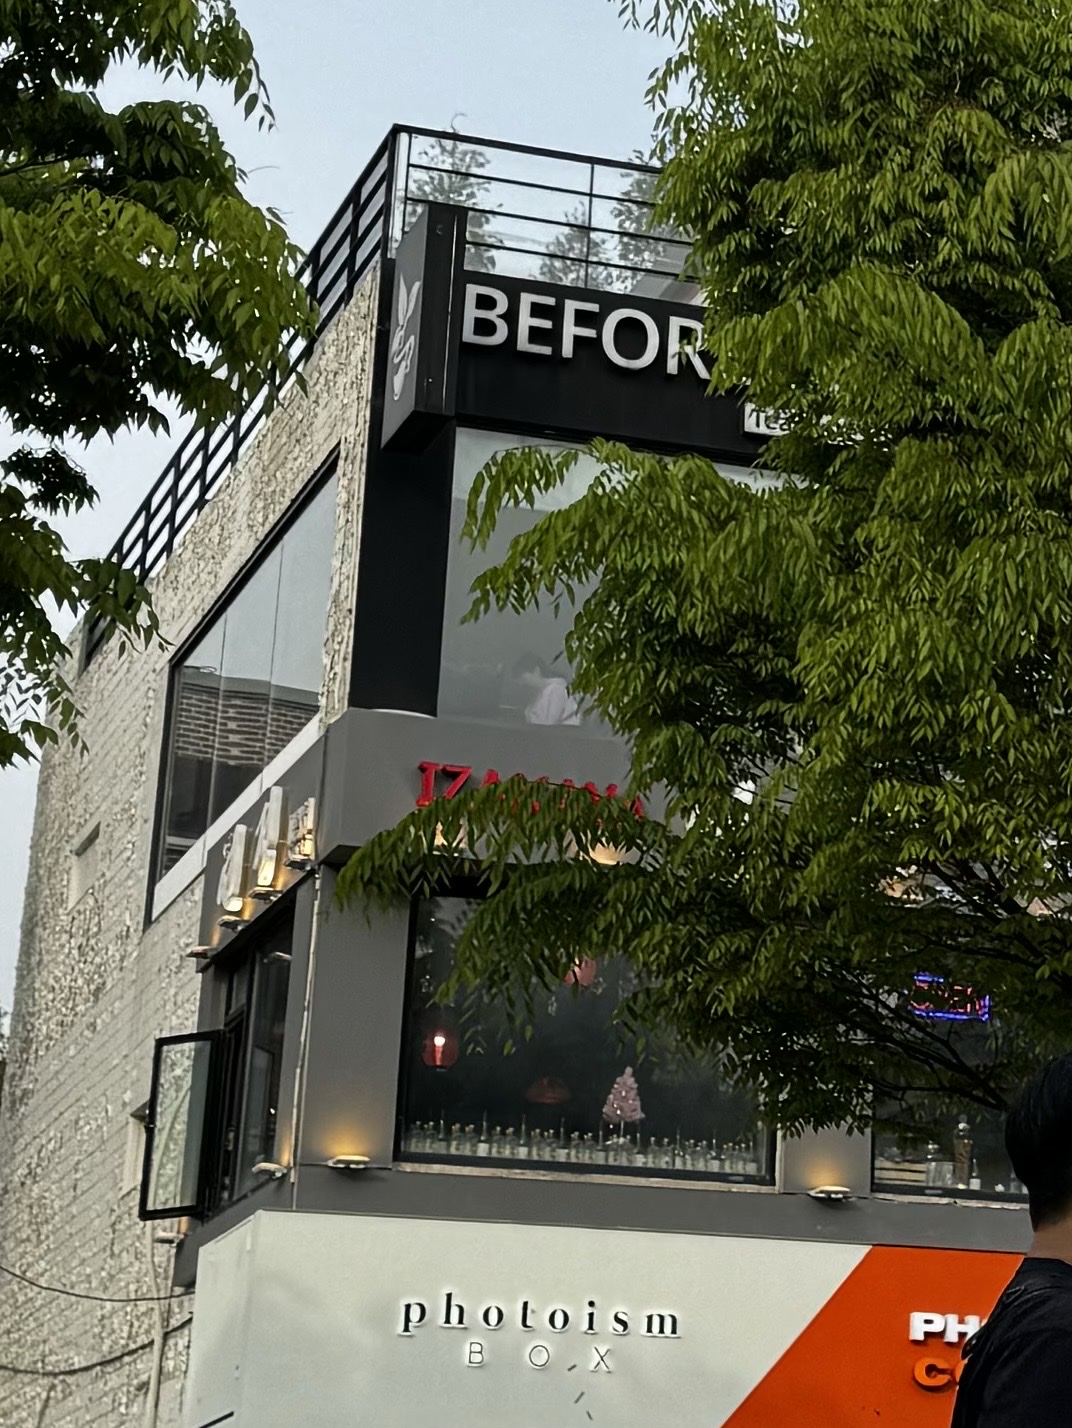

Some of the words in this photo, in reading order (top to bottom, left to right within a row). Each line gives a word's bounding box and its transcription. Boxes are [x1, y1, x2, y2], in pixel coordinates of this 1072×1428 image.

[462, 283, 711, 380] BEFOR
[399, 1291, 680, 1336] photoism
[467, 1341, 612, 1373] BOX
